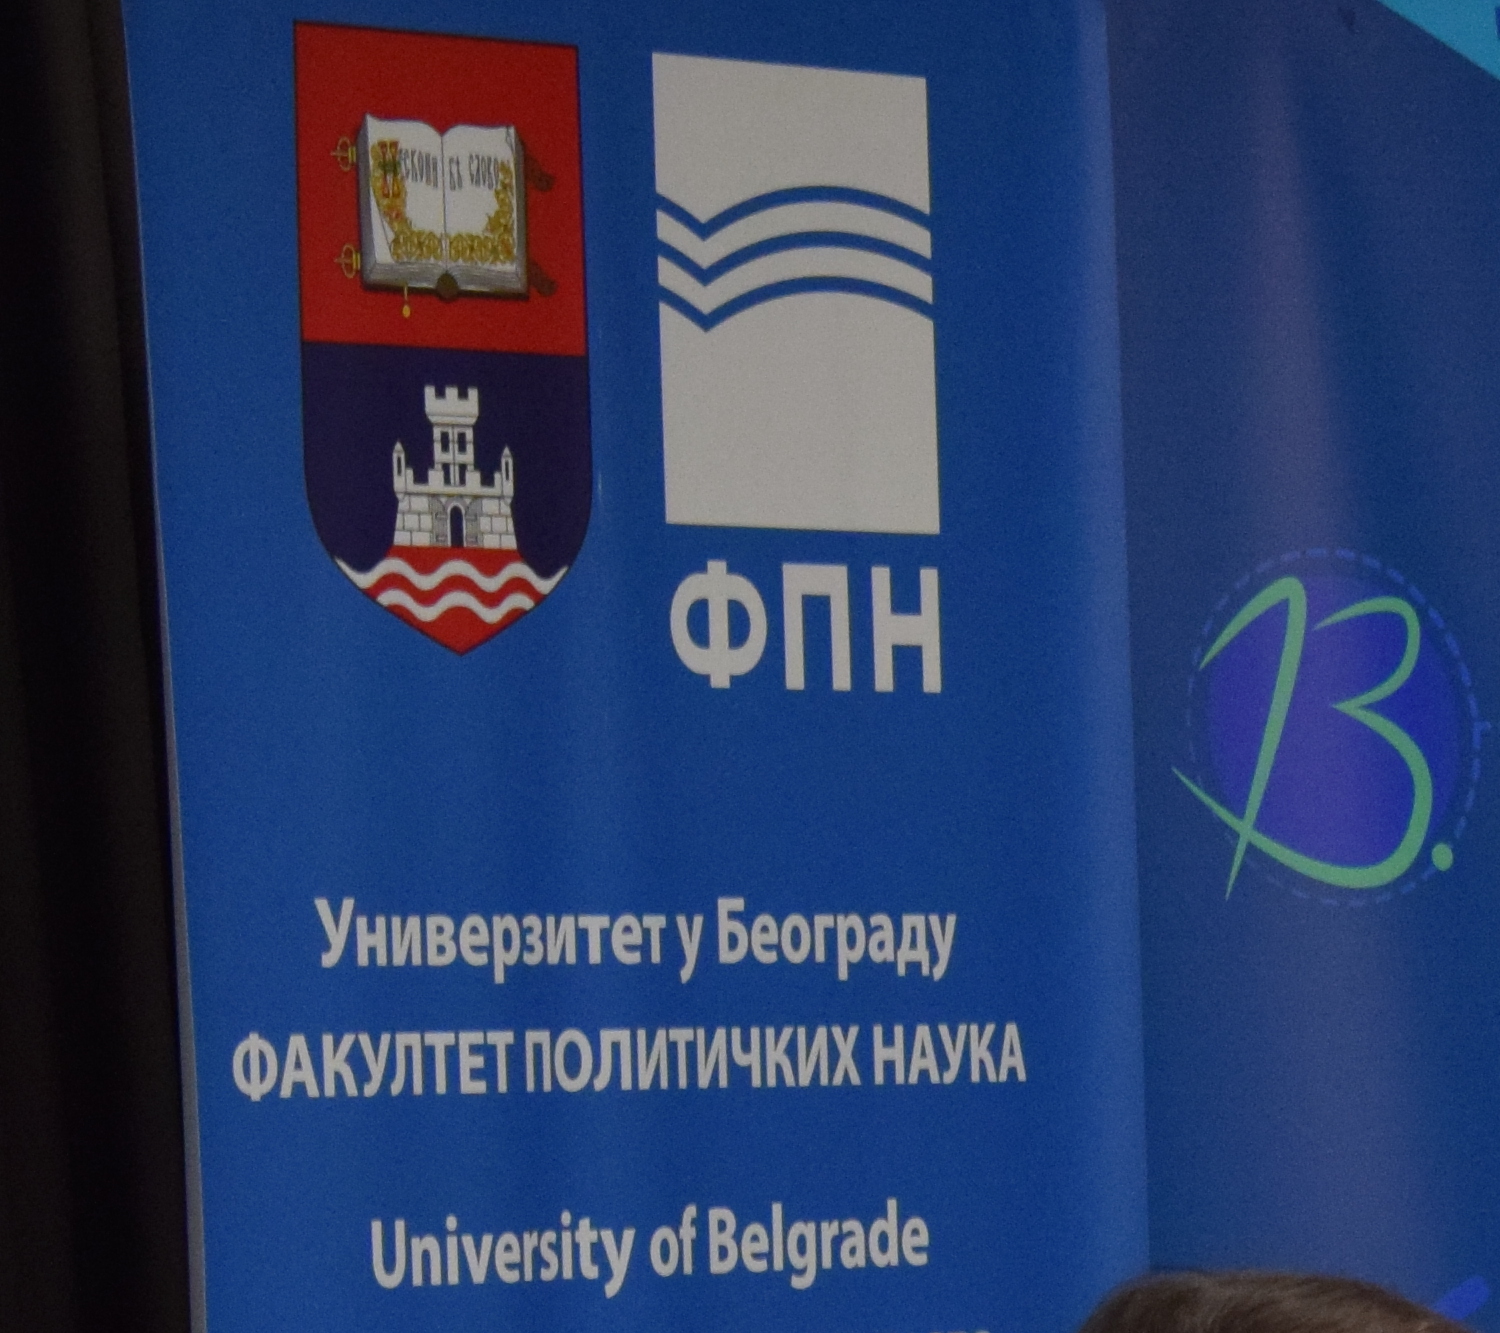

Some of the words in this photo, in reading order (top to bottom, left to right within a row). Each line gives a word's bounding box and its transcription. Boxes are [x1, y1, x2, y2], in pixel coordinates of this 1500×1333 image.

[669, 559, 942, 694] ФПН
[314, 897, 665, 983] Универзитет
[675, 913, 704, 982] у
[715, 897, 956, 981] Београду
[231, 1029, 515, 1102] ФАКУЛТЕТ
[524, 1024, 862, 1094] ПОЛИТИЧКИХ
[872, 1021, 1027, 1085] НАУКА
[370, 1208, 635, 1297] University
[650, 1205, 696, 1276] of
[708, 1198, 930, 1289] Belgrade
